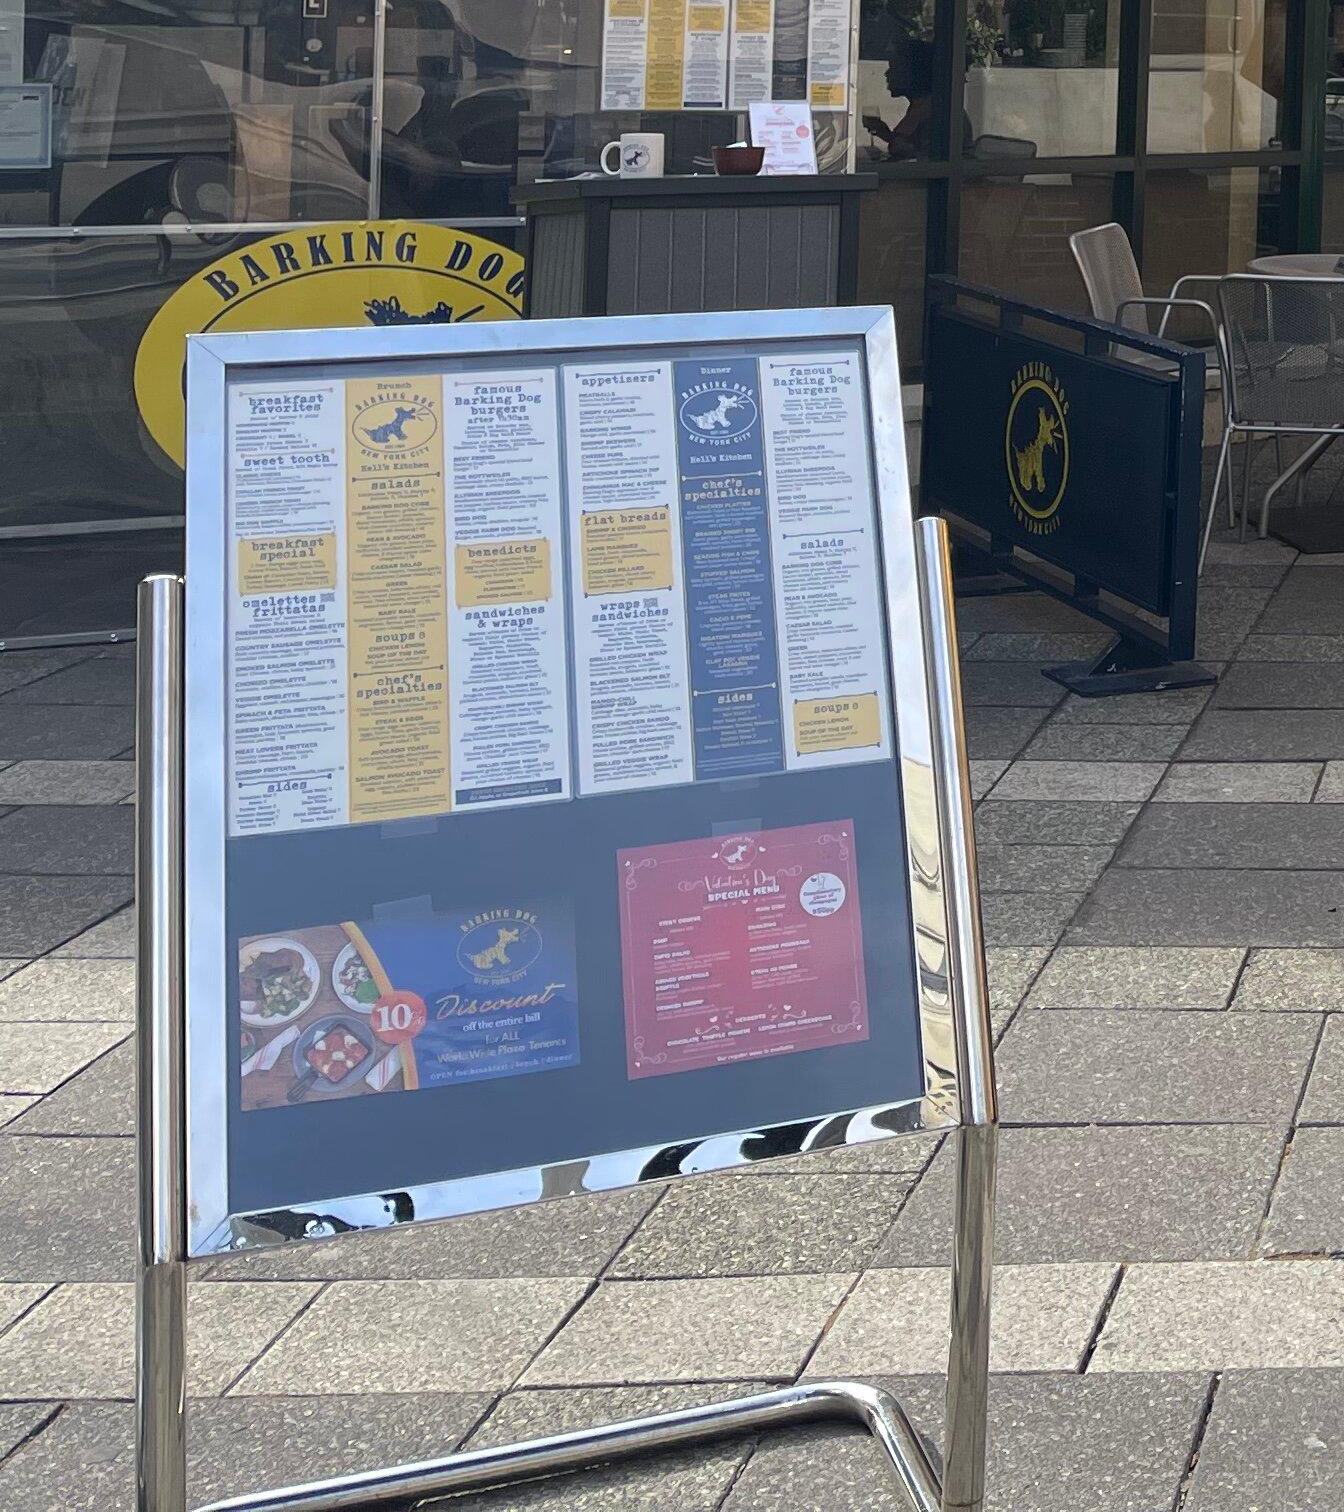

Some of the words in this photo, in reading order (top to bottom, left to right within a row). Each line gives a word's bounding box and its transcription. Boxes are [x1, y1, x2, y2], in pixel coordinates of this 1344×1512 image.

[202, 231, 418, 303] BARKING
[700, 367, 731, 375] Dinner
[789, 367, 833, 377] famous
[1010, 361, 1051, 394] BARKING
[773, 376, 825, 387] Barking
[830, 375, 851, 385] Dog
[474, 385, 522, 395] famous
[682, 381, 727, 400] BARKING
[733, 383, 754, 396] DOG
[787, 386, 838, 396] burgers
[249, 394, 324, 406] breakfast
[355, 392, 405, 411] BARKING
[413, 394, 436, 408] DOG
[454, 395, 512, 406] Barking
[518, 393, 541, 404] Dog
[251, 402, 321, 414] favorites
[471, 404, 527, 417] burgers
[689, 434, 706, 445] NEW
[709, 438, 731, 446] YORK
[733, 431, 752, 443] CITY
[361, 449, 379, 459] NEW
[410, 446, 429, 457] CITY
[690, 455, 717, 464] Hell's
[719, 453, 752, 462] Kitchen
[244, 456, 285, 466] sweet
[291, 453, 330, 464] tooth
[361, 463, 390, 472] Hell's
[393, 461, 429, 470] Kitchen
[371, 479, 420, 490] salads
[702, 477, 742, 489] chef's
[684, 487, 761, 502] specialties
[584, 515, 615, 526] flat
[620, 511, 667, 524] breads
[251, 537, 325, 551] breakfast
[801, 538, 844, 549] salads
[260, 548, 316, 562] special
[468, 545, 537, 558] benedicts
[242, 595, 316, 608] omelettes
[600, 599, 640, 611] wraps
[252, 603, 326, 617] frittatas
[465, 606, 545, 620] sandwiches
[592, 608, 669, 622] sandwiches
[493, 617, 533, 628] wraps
[375, 631, 416, 643] soups
[377, 673, 422, 686] chef's
[356, 682, 442, 700] specialties
[717, 692, 753, 704] sides
[814, 703, 849, 714] soups
[268, 781, 307, 793] sides
[708, 889, 750, 902] SPECIAL
[753, 885, 780, 896] MENU
[460, 909, 510, 932] BARKING
[515, 909, 538, 924] DOG
[511, 970, 528, 982] CITY
[436, 983, 566, 1020] Discount
[462, 1021, 477, 1032] off
[478, 1020, 493, 1029] the
[495, 1016, 523, 1028] entire
[525, 1012, 540, 1023] bill
[501, 1032, 520, 1041] ALL
